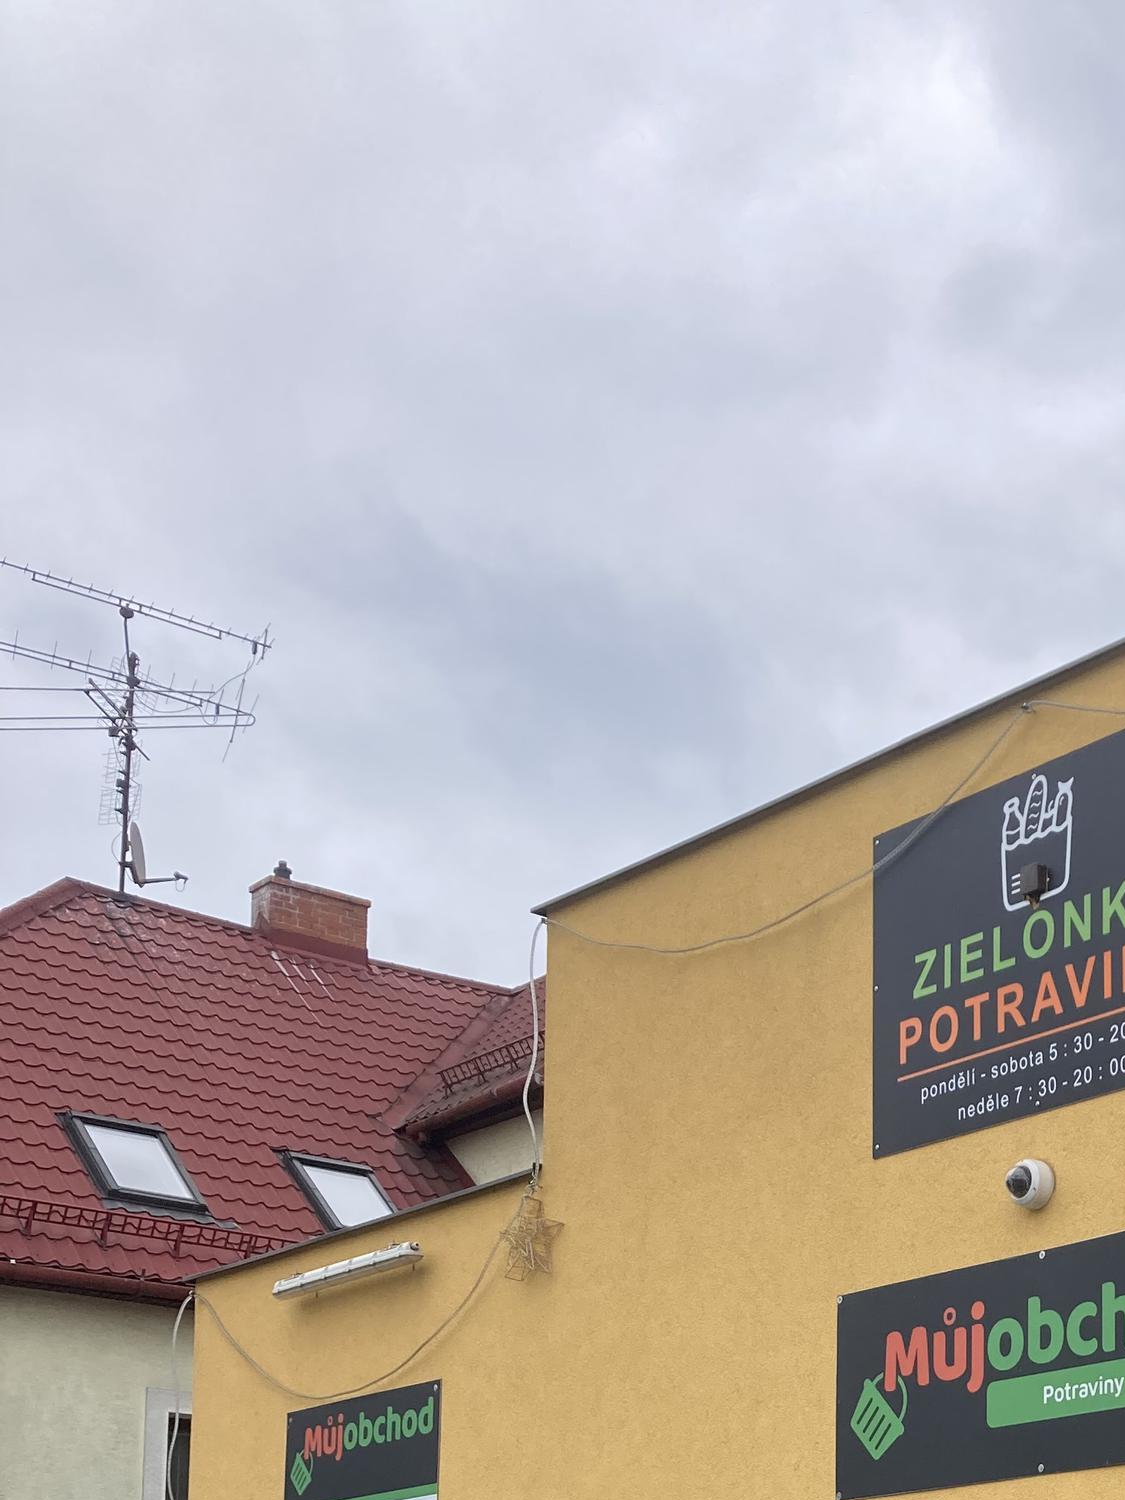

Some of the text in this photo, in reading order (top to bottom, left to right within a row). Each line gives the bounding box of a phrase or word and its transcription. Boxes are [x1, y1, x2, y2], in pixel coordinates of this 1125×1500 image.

[921, 1068, 976, 1104] pondělí
[991, 1050, 1044, 1079] sobota
[957, 1093, 1009, 1121] neděle
[1043, 1374, 1125, 1404] Potraviny
